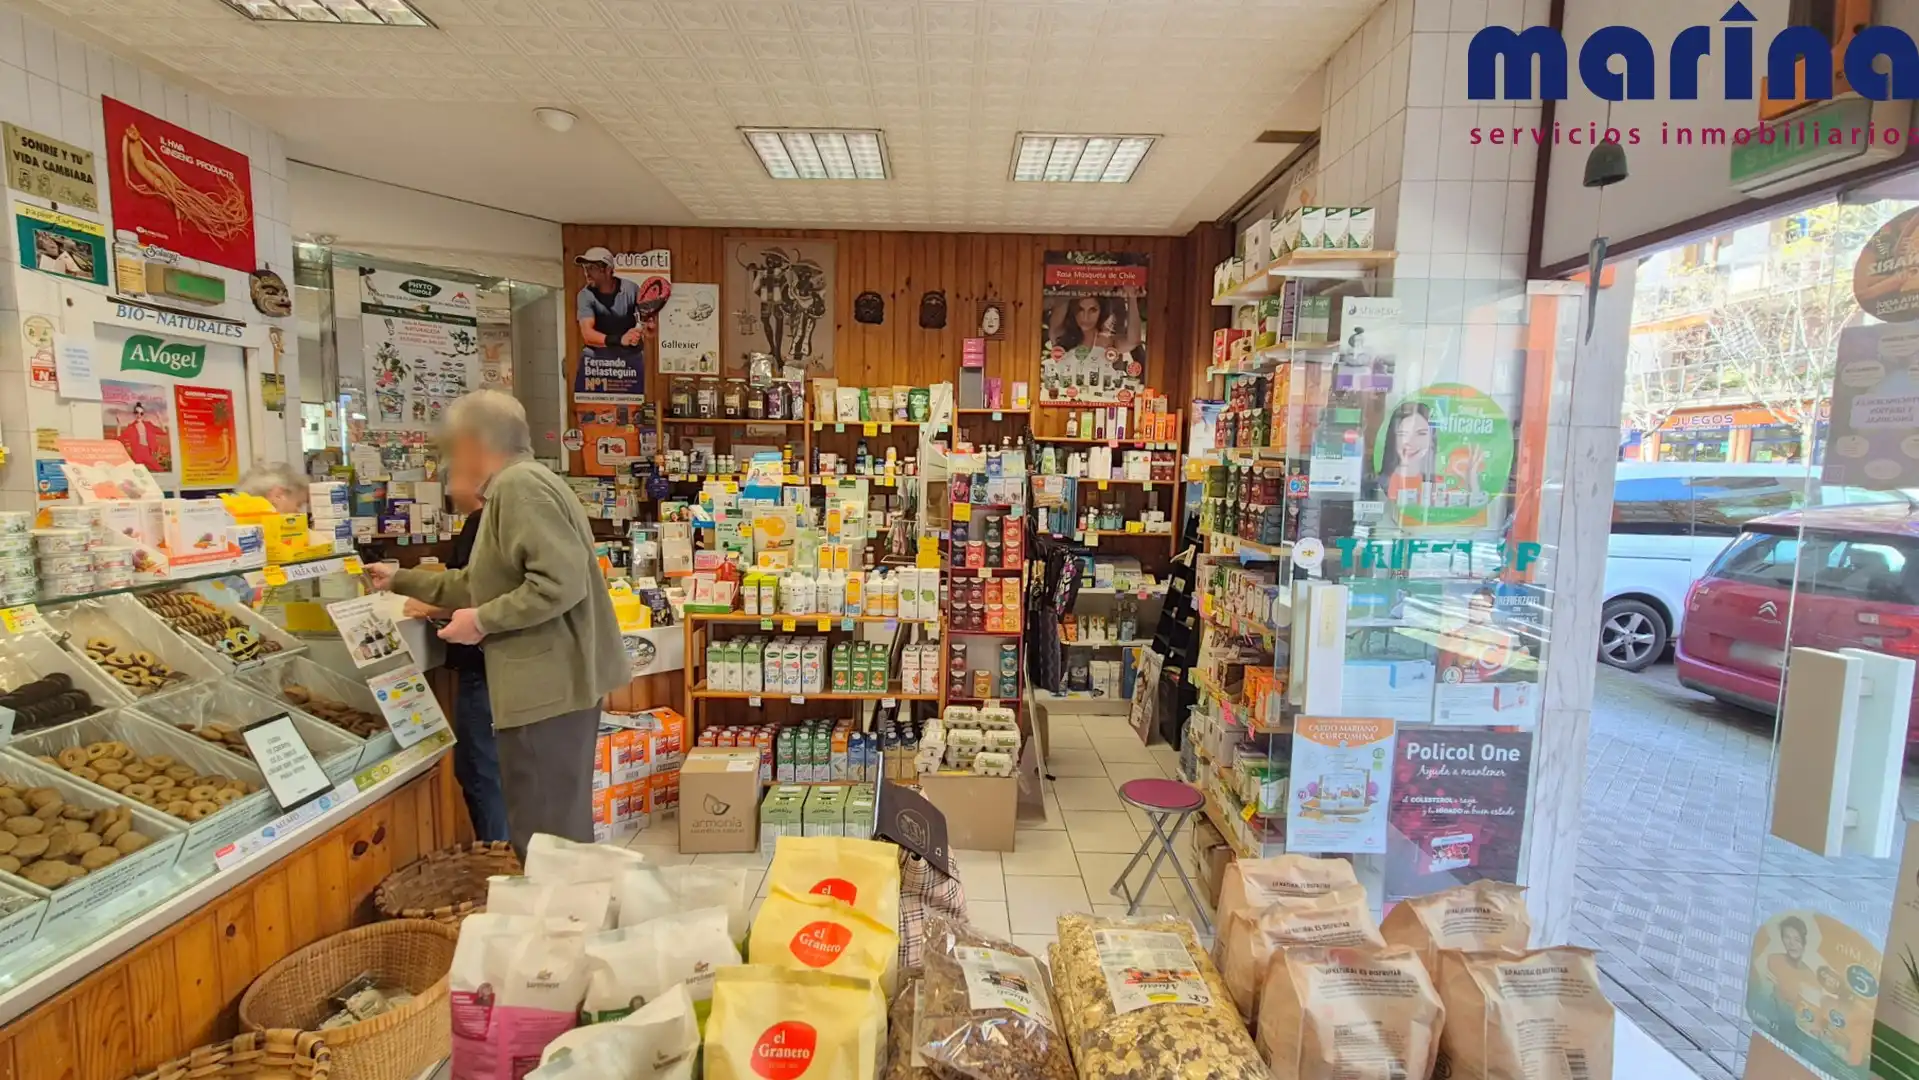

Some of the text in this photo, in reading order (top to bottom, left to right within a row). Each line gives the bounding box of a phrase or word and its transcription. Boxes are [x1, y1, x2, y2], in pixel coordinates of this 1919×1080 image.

[13, 149, 40, 169] VIDA
[61, 148, 68, 161] Y
[71, 152, 83, 166] TU
[195, 158, 235, 181] PRODUCTS
[660, 339, 700, 350] Gallexier
[130, 343, 197, 371] A.Vogel
[584, 355, 627, 367] Fernando
[1674, 413, 1734, 427] JUEGOS
[1406, 742, 1521, 762] Policol One
[1460, 765, 1508, 777] mantener
[692, 816, 742, 828] armonia
[814, 928, 825, 939] el
[799, 933, 841, 953] Granero
[773, 1029, 786, 1045] el
[758, 1043, 810, 1058] Granero
